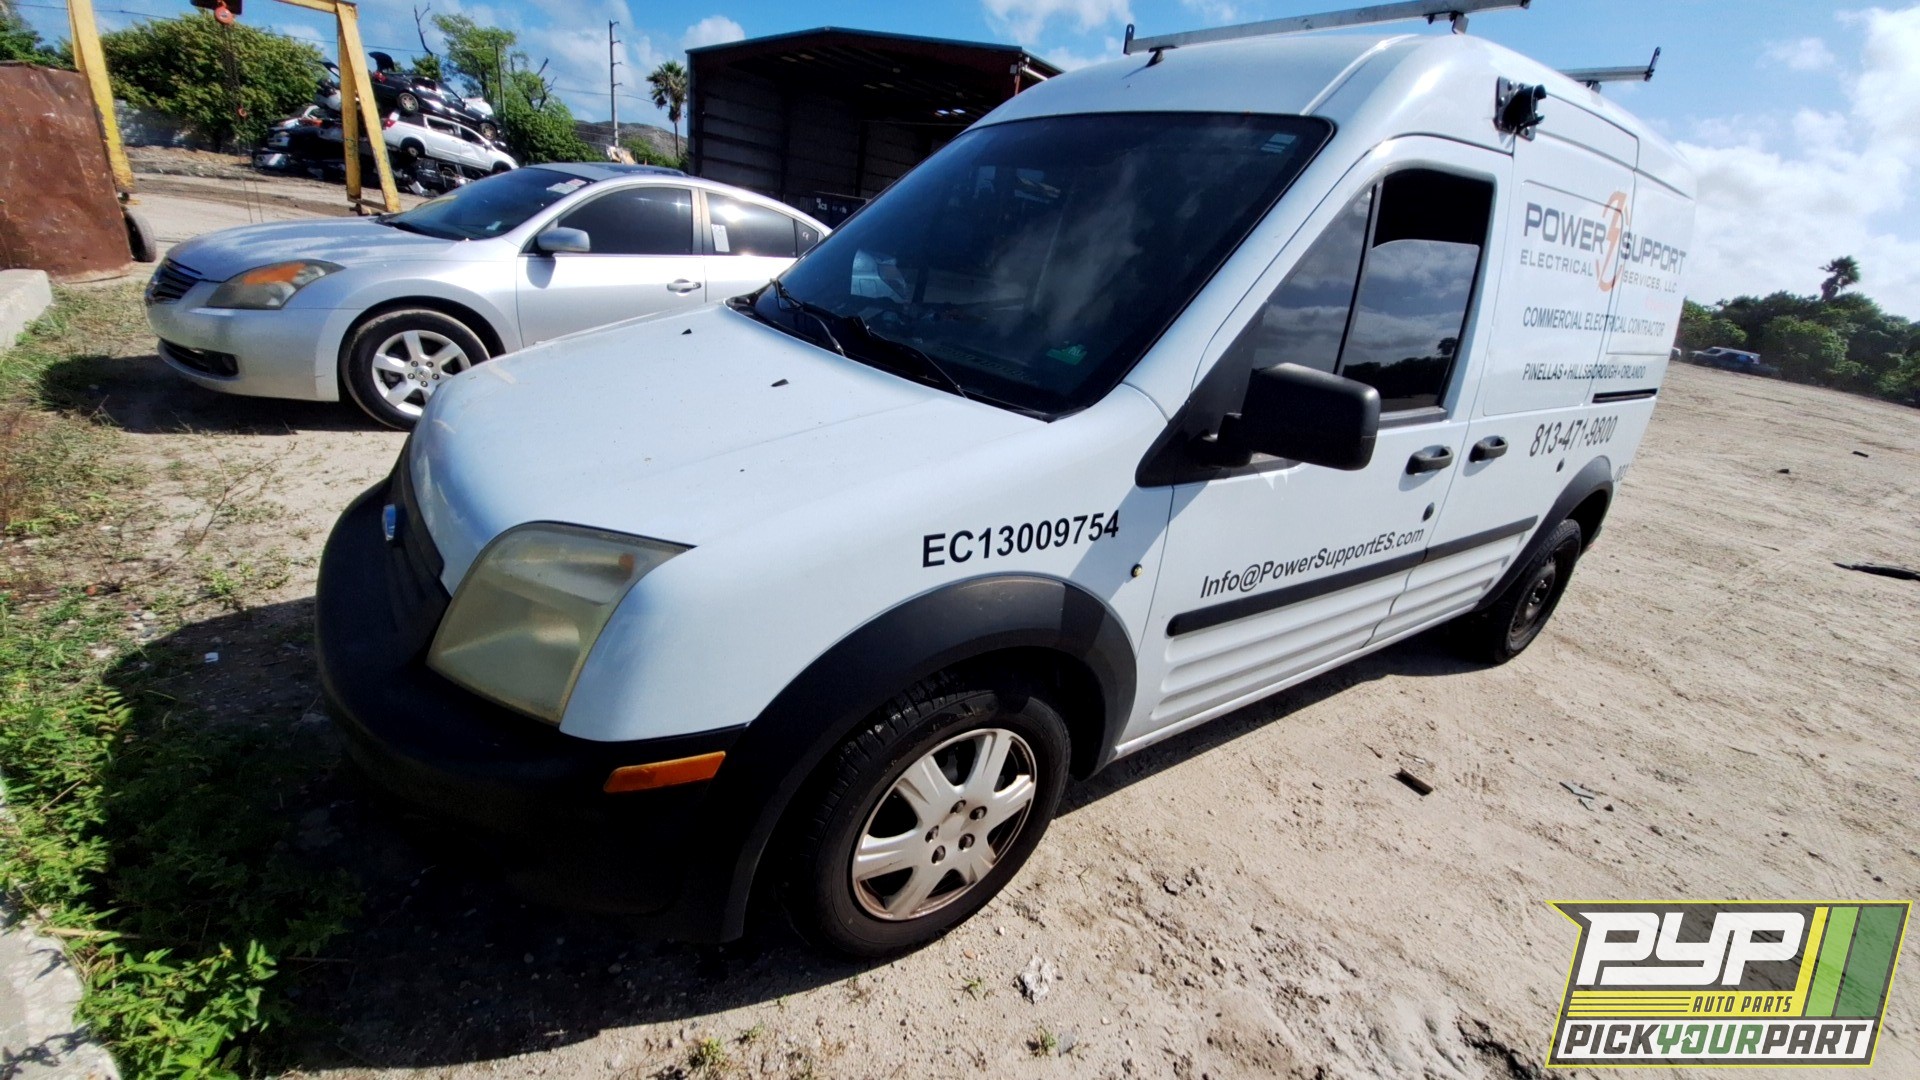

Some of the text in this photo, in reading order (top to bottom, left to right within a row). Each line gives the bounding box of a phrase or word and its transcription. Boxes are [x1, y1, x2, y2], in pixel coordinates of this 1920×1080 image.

[1523, 202, 1686, 275] POWER SUPPORT
[1520, 249, 1678, 293] ELECTRICAL SERVICES, LLC
[1523, 306, 1666, 337] COMMERCIAL ELECTRICAL CONTRACTOR
[1522, 363, 1646, 380] PINELLAS HILLSBOROUGH ORLANDO
[1529, 415, 1618, 457] 813-471-9800
[922, 509, 1119, 568] EC13009754
[1200, 528, 1424, 598] Info@PowerSupportES.com
